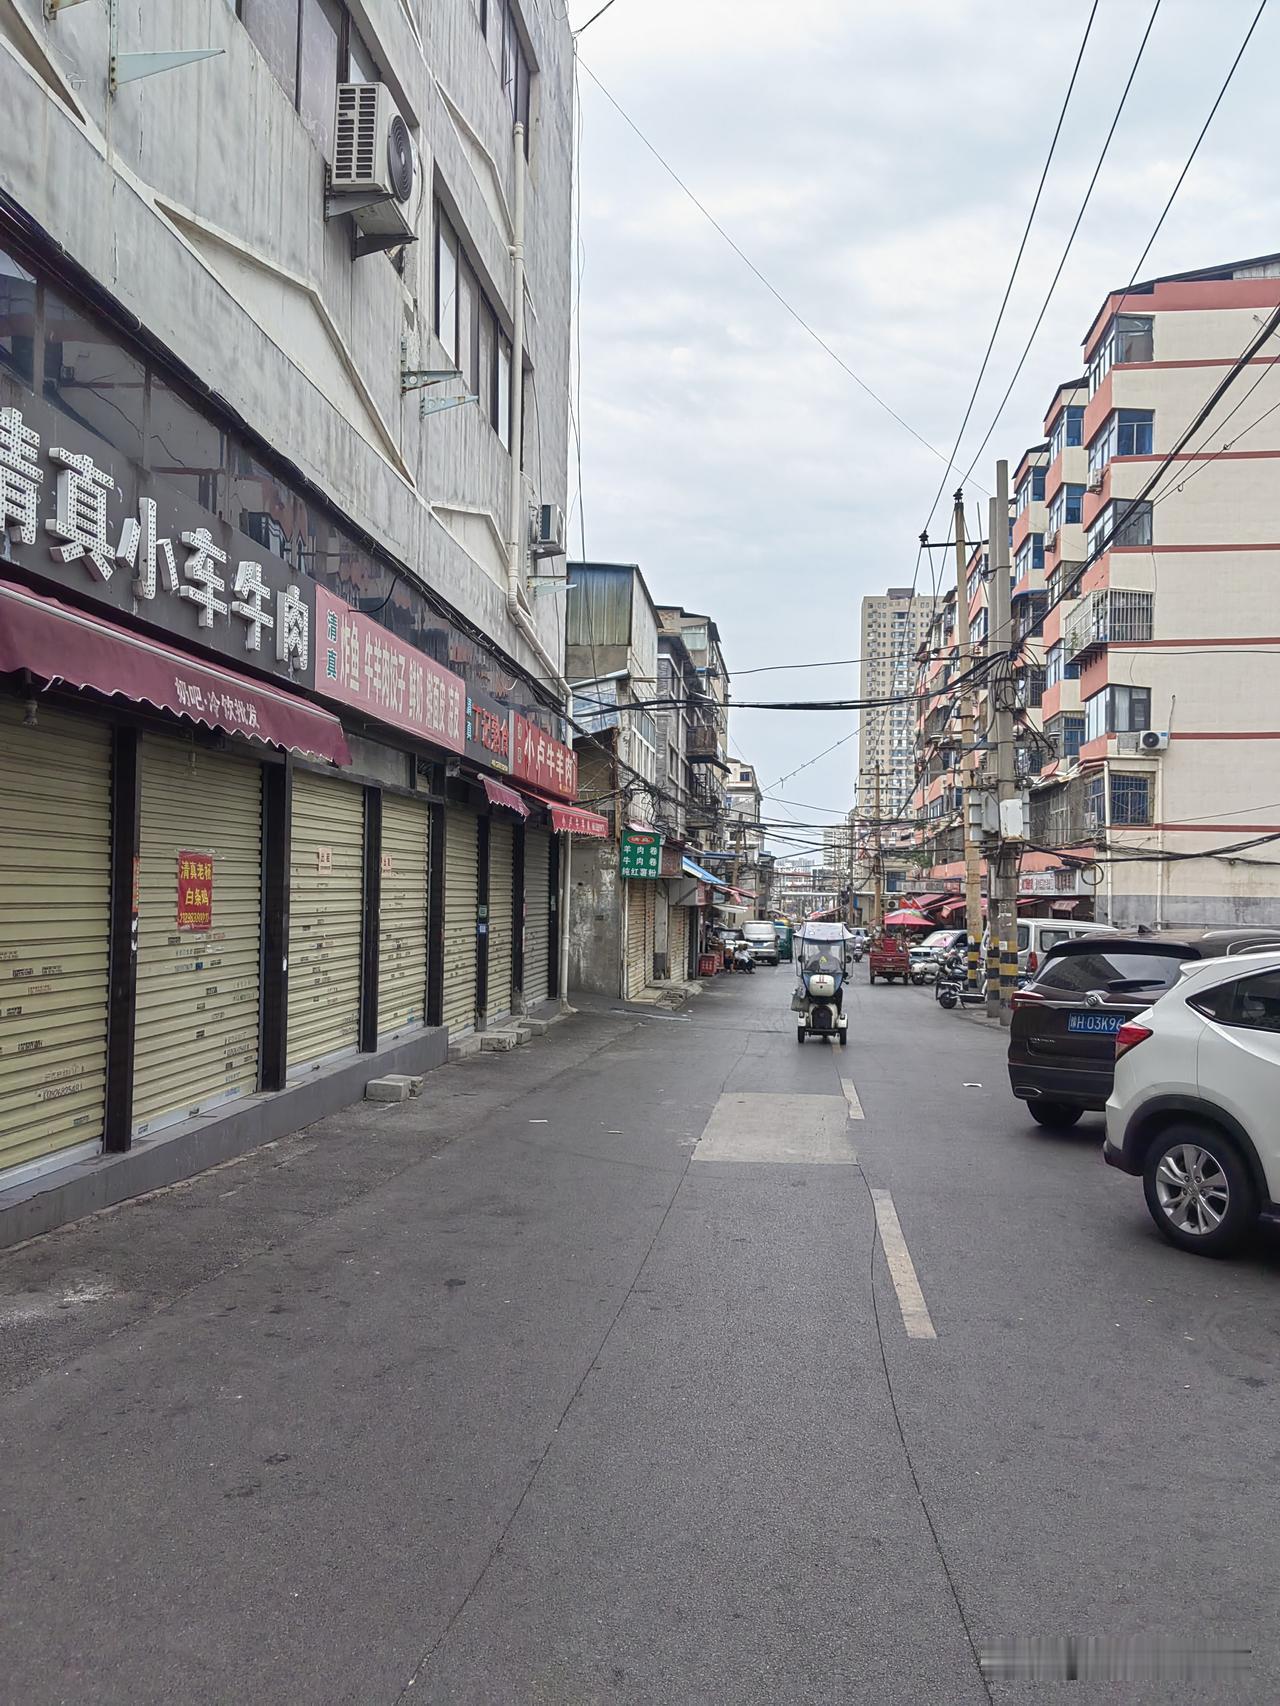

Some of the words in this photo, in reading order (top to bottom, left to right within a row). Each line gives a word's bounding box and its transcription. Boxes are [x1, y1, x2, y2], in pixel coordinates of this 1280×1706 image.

[327, 609, 337, 680] 清真
[340, 613, 359, 692] 炸鱼
[365, 632, 406, 714] 牛羊肉饺子
[623, 845, 657, 856] 羊肉卷
[180, 860, 212, 881] 清真老杨
[622, 856, 657, 867] 牛肉卷
[185, 887, 209, 906] 白条鸡
